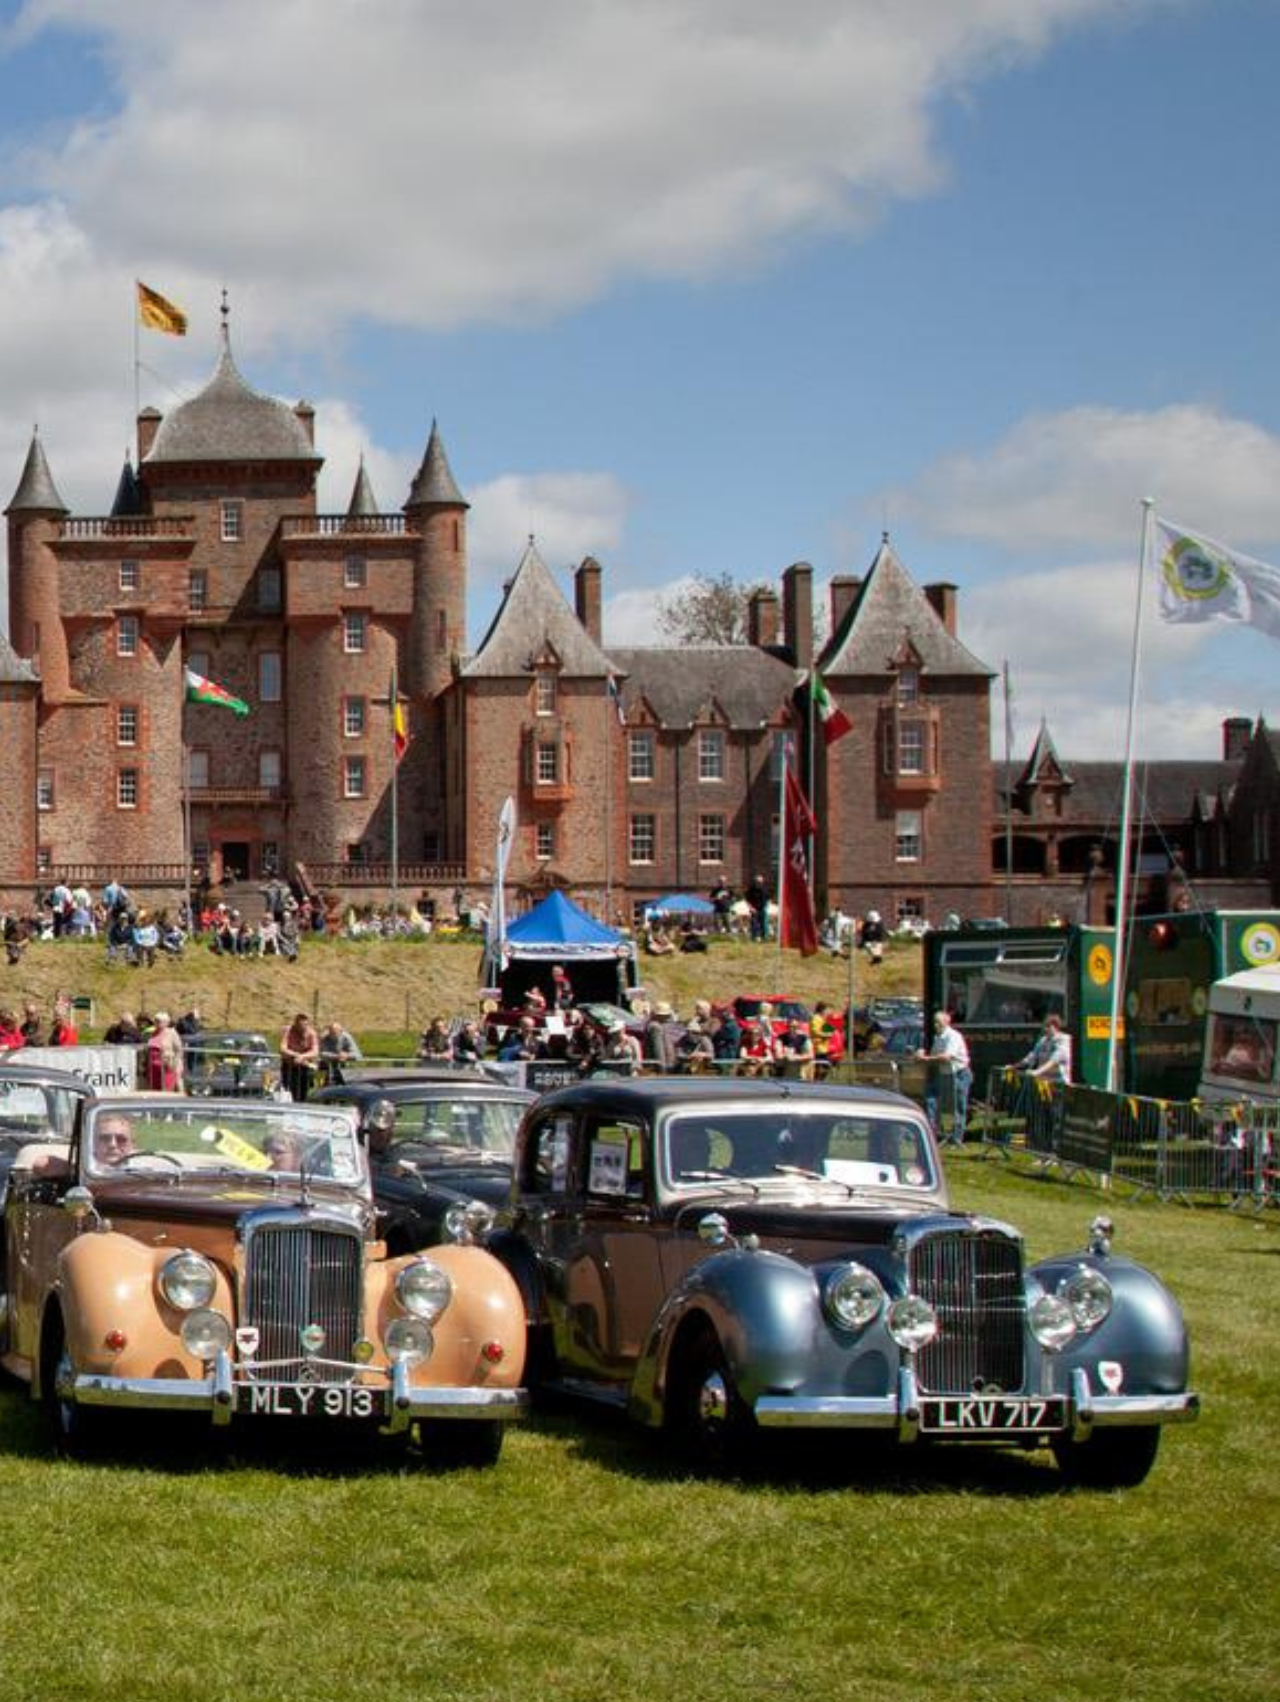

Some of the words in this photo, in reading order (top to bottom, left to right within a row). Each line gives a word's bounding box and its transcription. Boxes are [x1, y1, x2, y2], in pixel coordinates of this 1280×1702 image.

[251, 1386, 315, 1415] MLY
[324, 1388, 372, 1417] 913
[938, 1401, 996, 1428] LKV
[1002, 1402, 1047, 1428] 717
